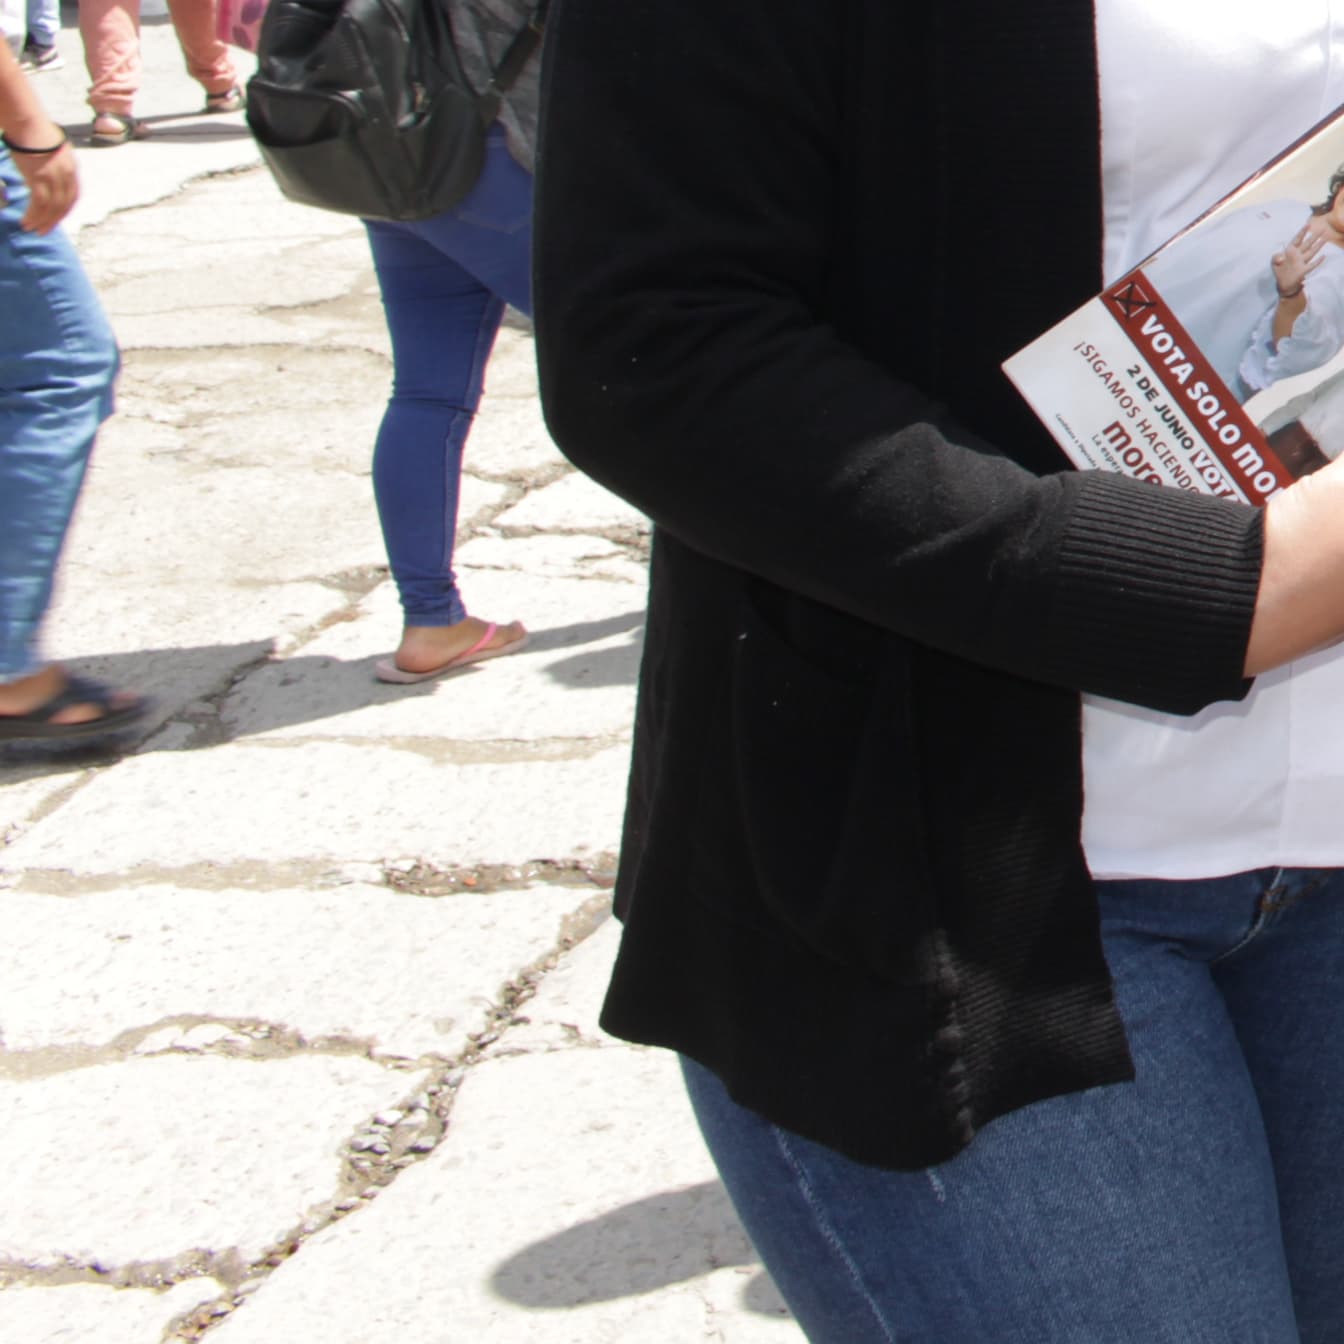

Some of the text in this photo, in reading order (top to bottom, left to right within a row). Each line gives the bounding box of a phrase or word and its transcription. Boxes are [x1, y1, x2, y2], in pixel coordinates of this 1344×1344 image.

[1072, 337, 1142, 421] ¡SIGAMOS
[1125, 363, 1142, 379] 2
[1134, 375, 1160, 403] DE
[1152, 399, 1197, 452] JUNIO
[1135, 312, 1198, 385] VOTA
[1183, 377, 1245, 449] SOLO
